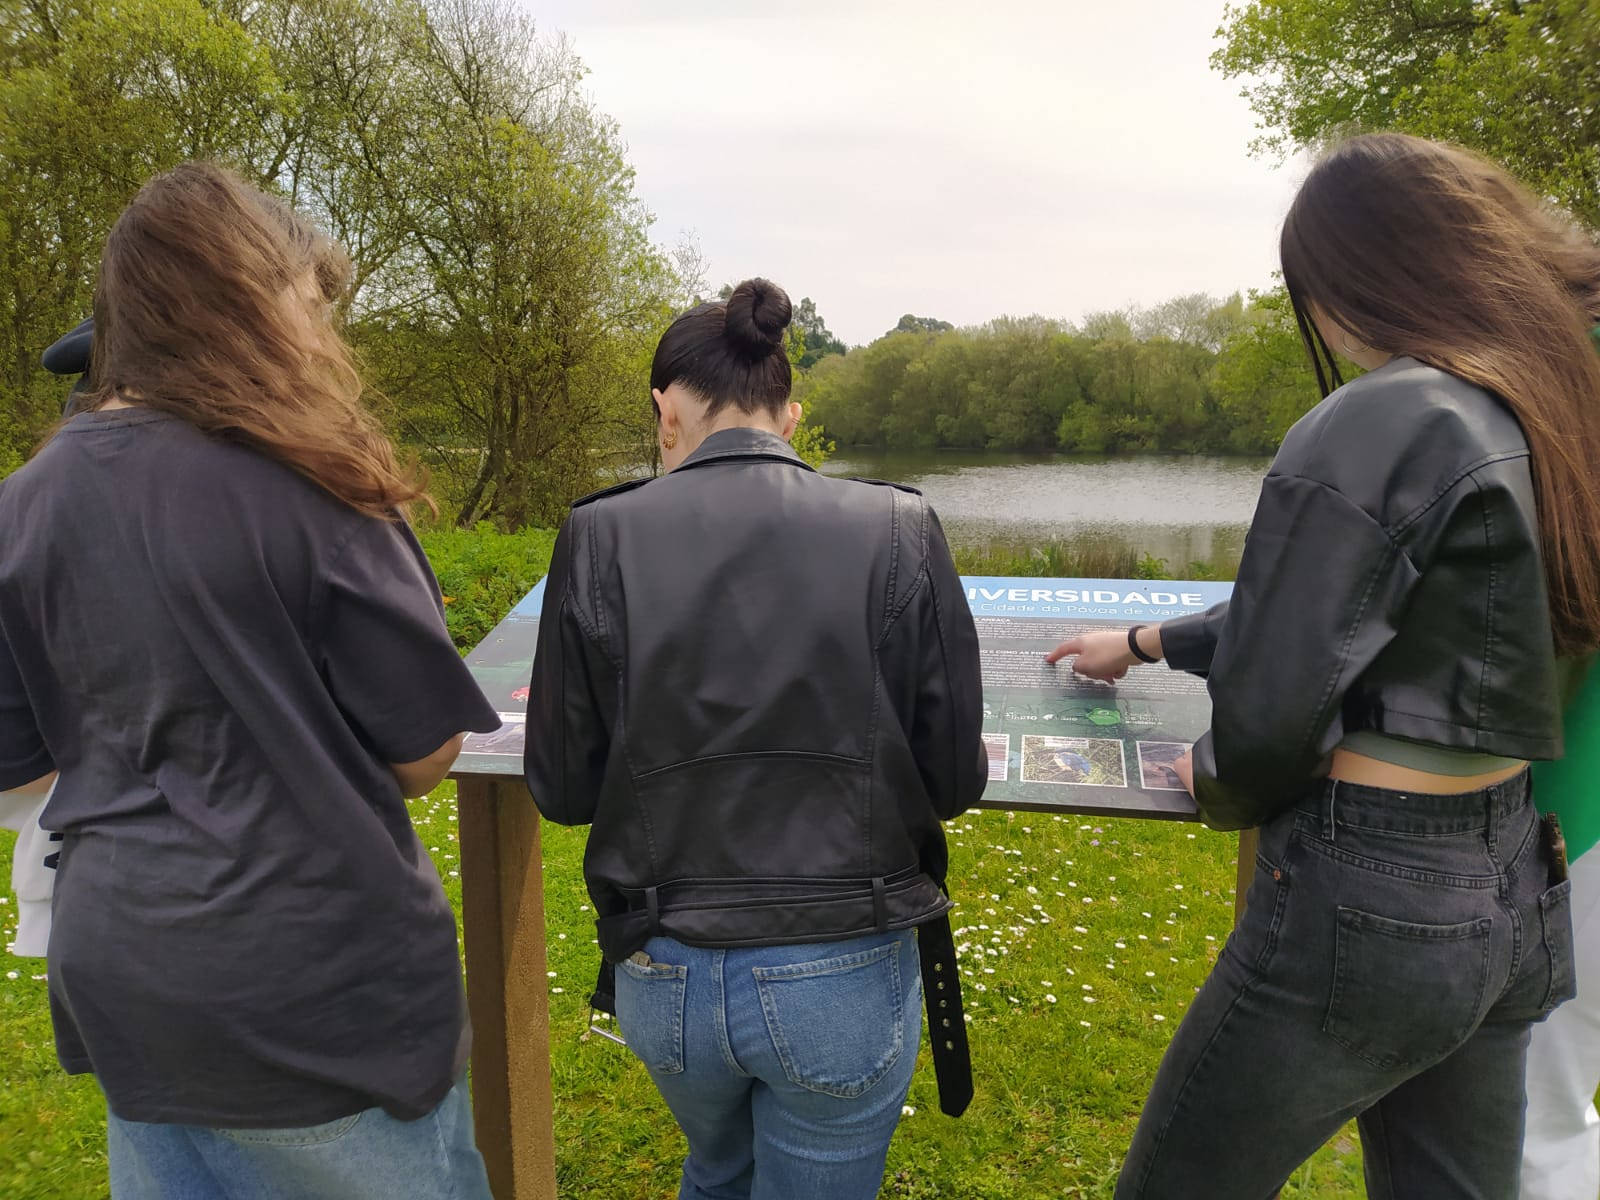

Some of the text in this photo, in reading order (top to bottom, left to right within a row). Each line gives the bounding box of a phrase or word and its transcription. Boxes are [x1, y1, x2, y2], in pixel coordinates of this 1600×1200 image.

[968, 587, 1204, 606] IVERSIDADE
[981, 602, 1035, 612] Cidade
[1041, 604, 1060, 613] da
[1067, 604, 1117, 615] Póvoa
[1124, 607, 1144, 616] de
